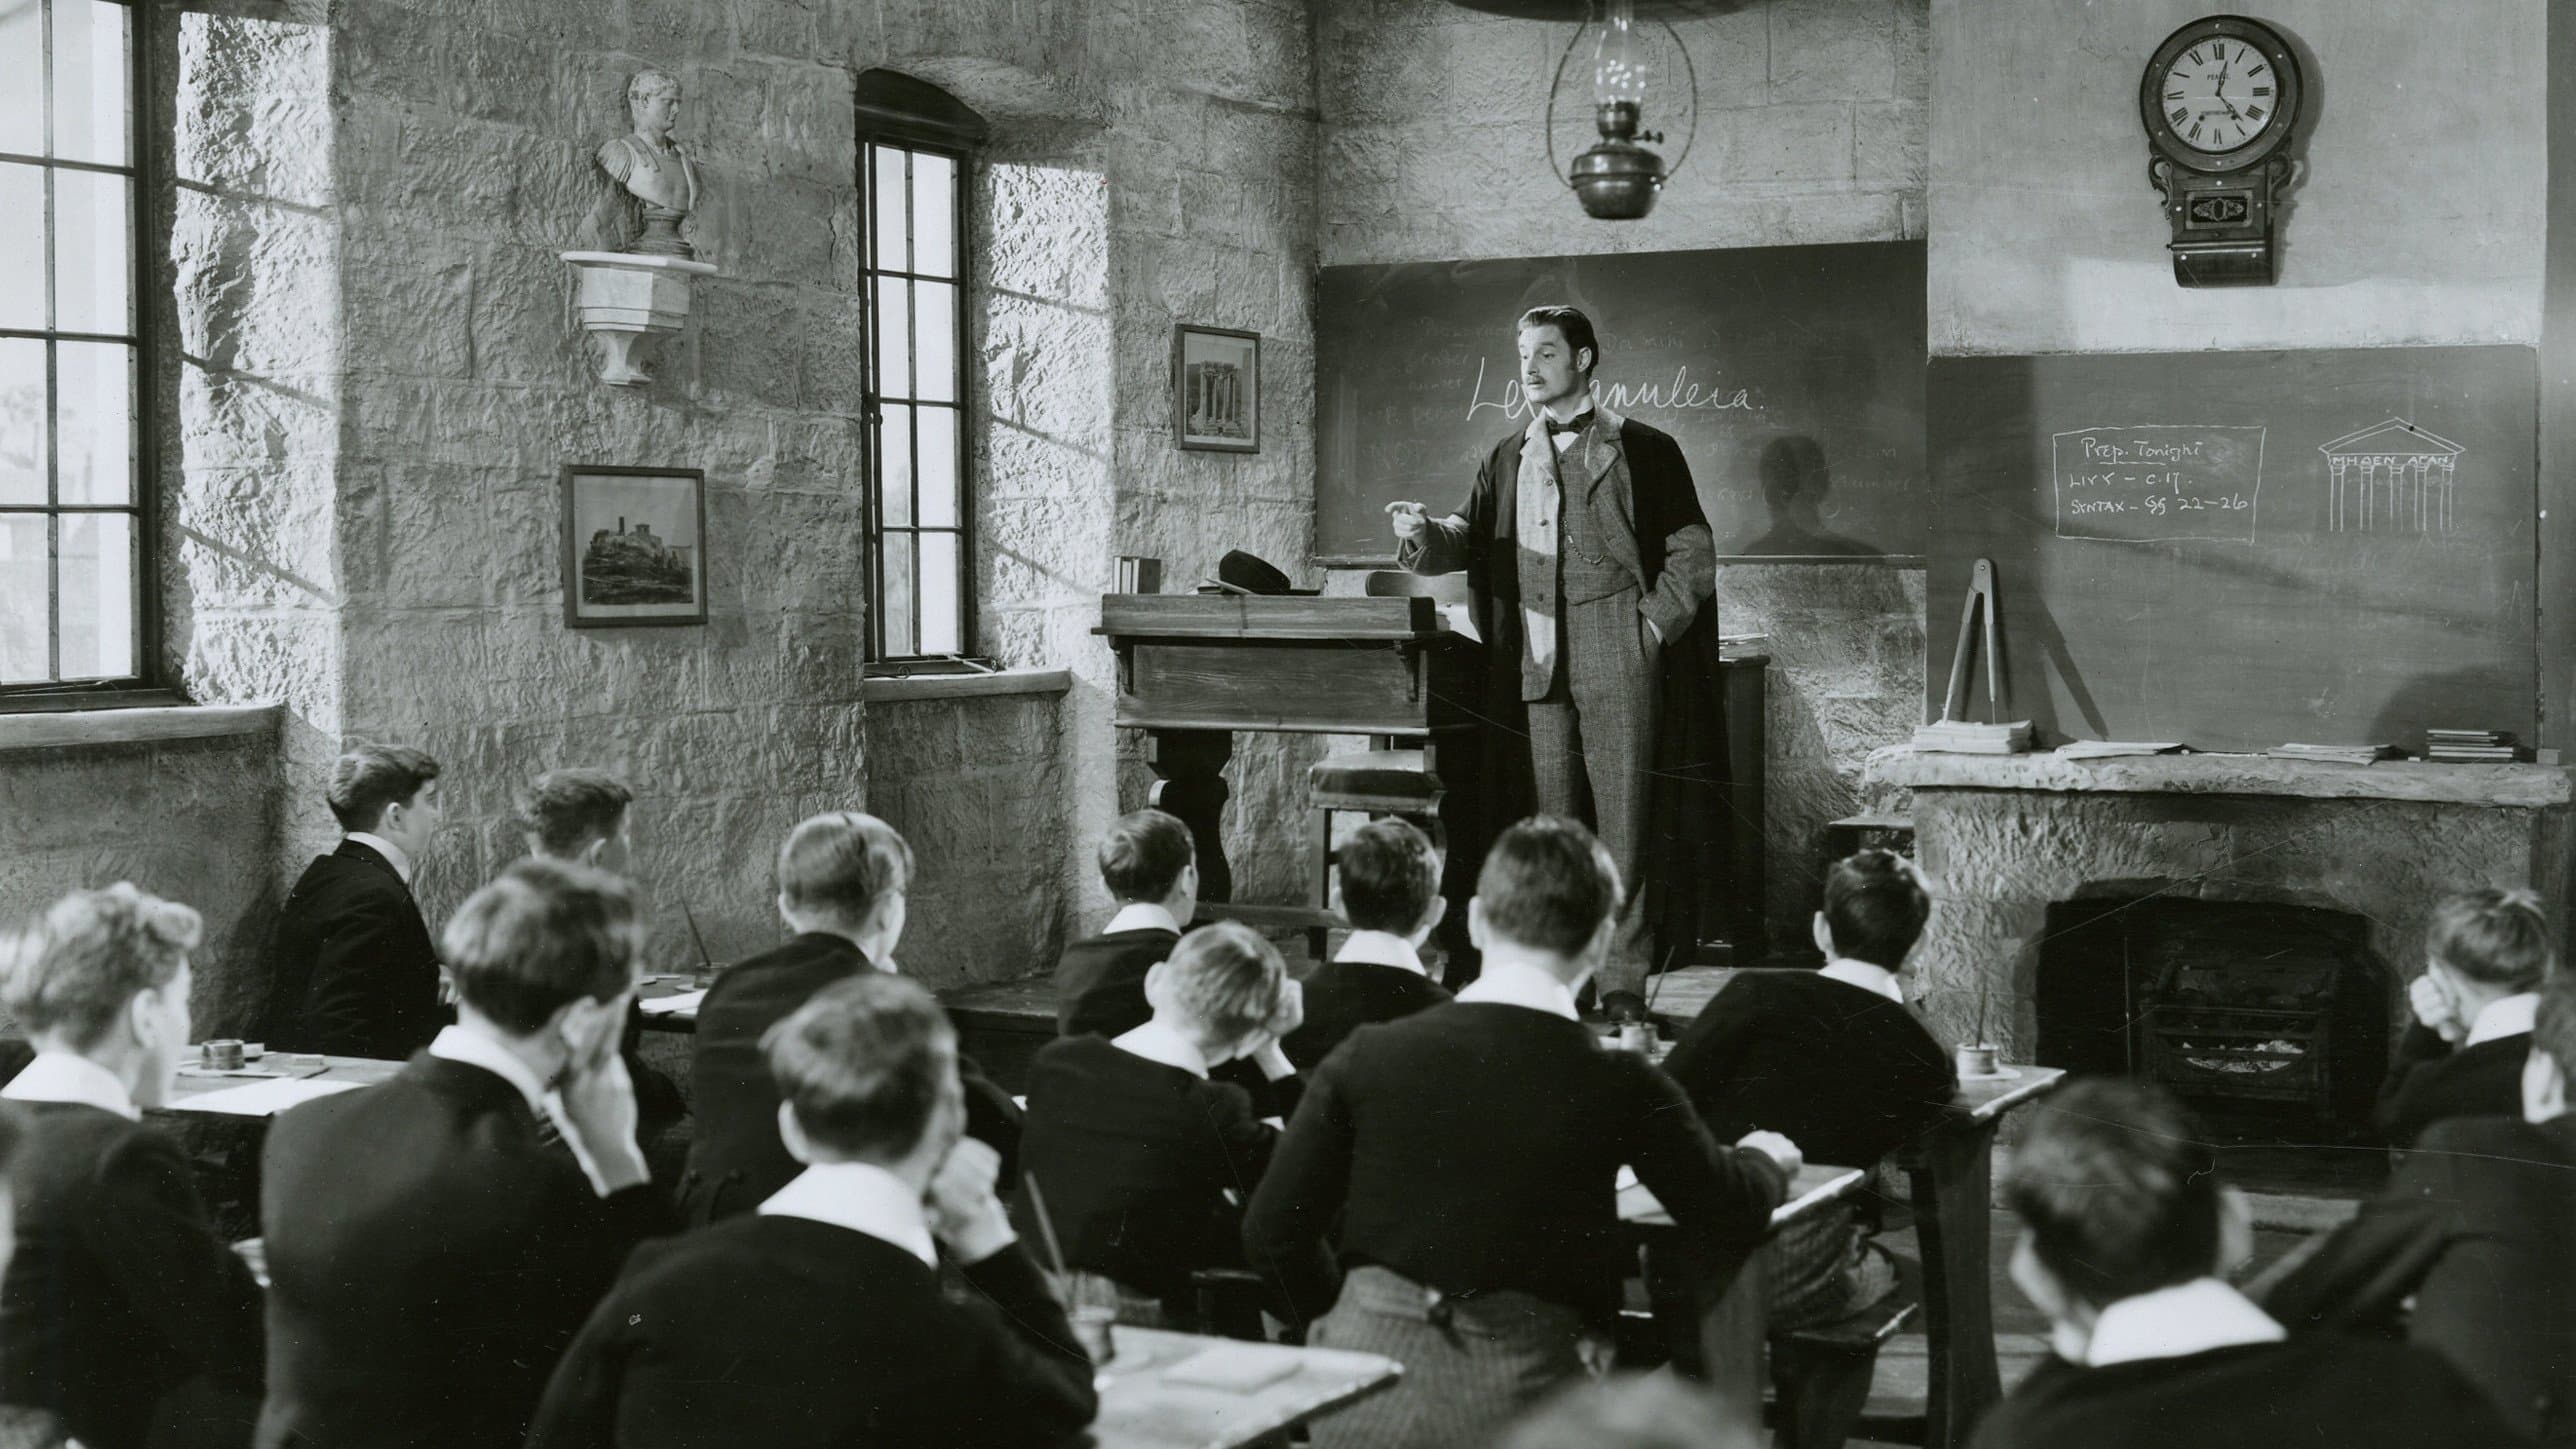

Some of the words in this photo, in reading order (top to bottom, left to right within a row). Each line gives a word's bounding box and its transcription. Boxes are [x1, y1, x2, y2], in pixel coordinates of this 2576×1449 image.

[1588, 365, 1765, 411] anuleia.
[2080, 437, 2129, 464] Prep.
[2133, 439, 2204, 462] Tonight
